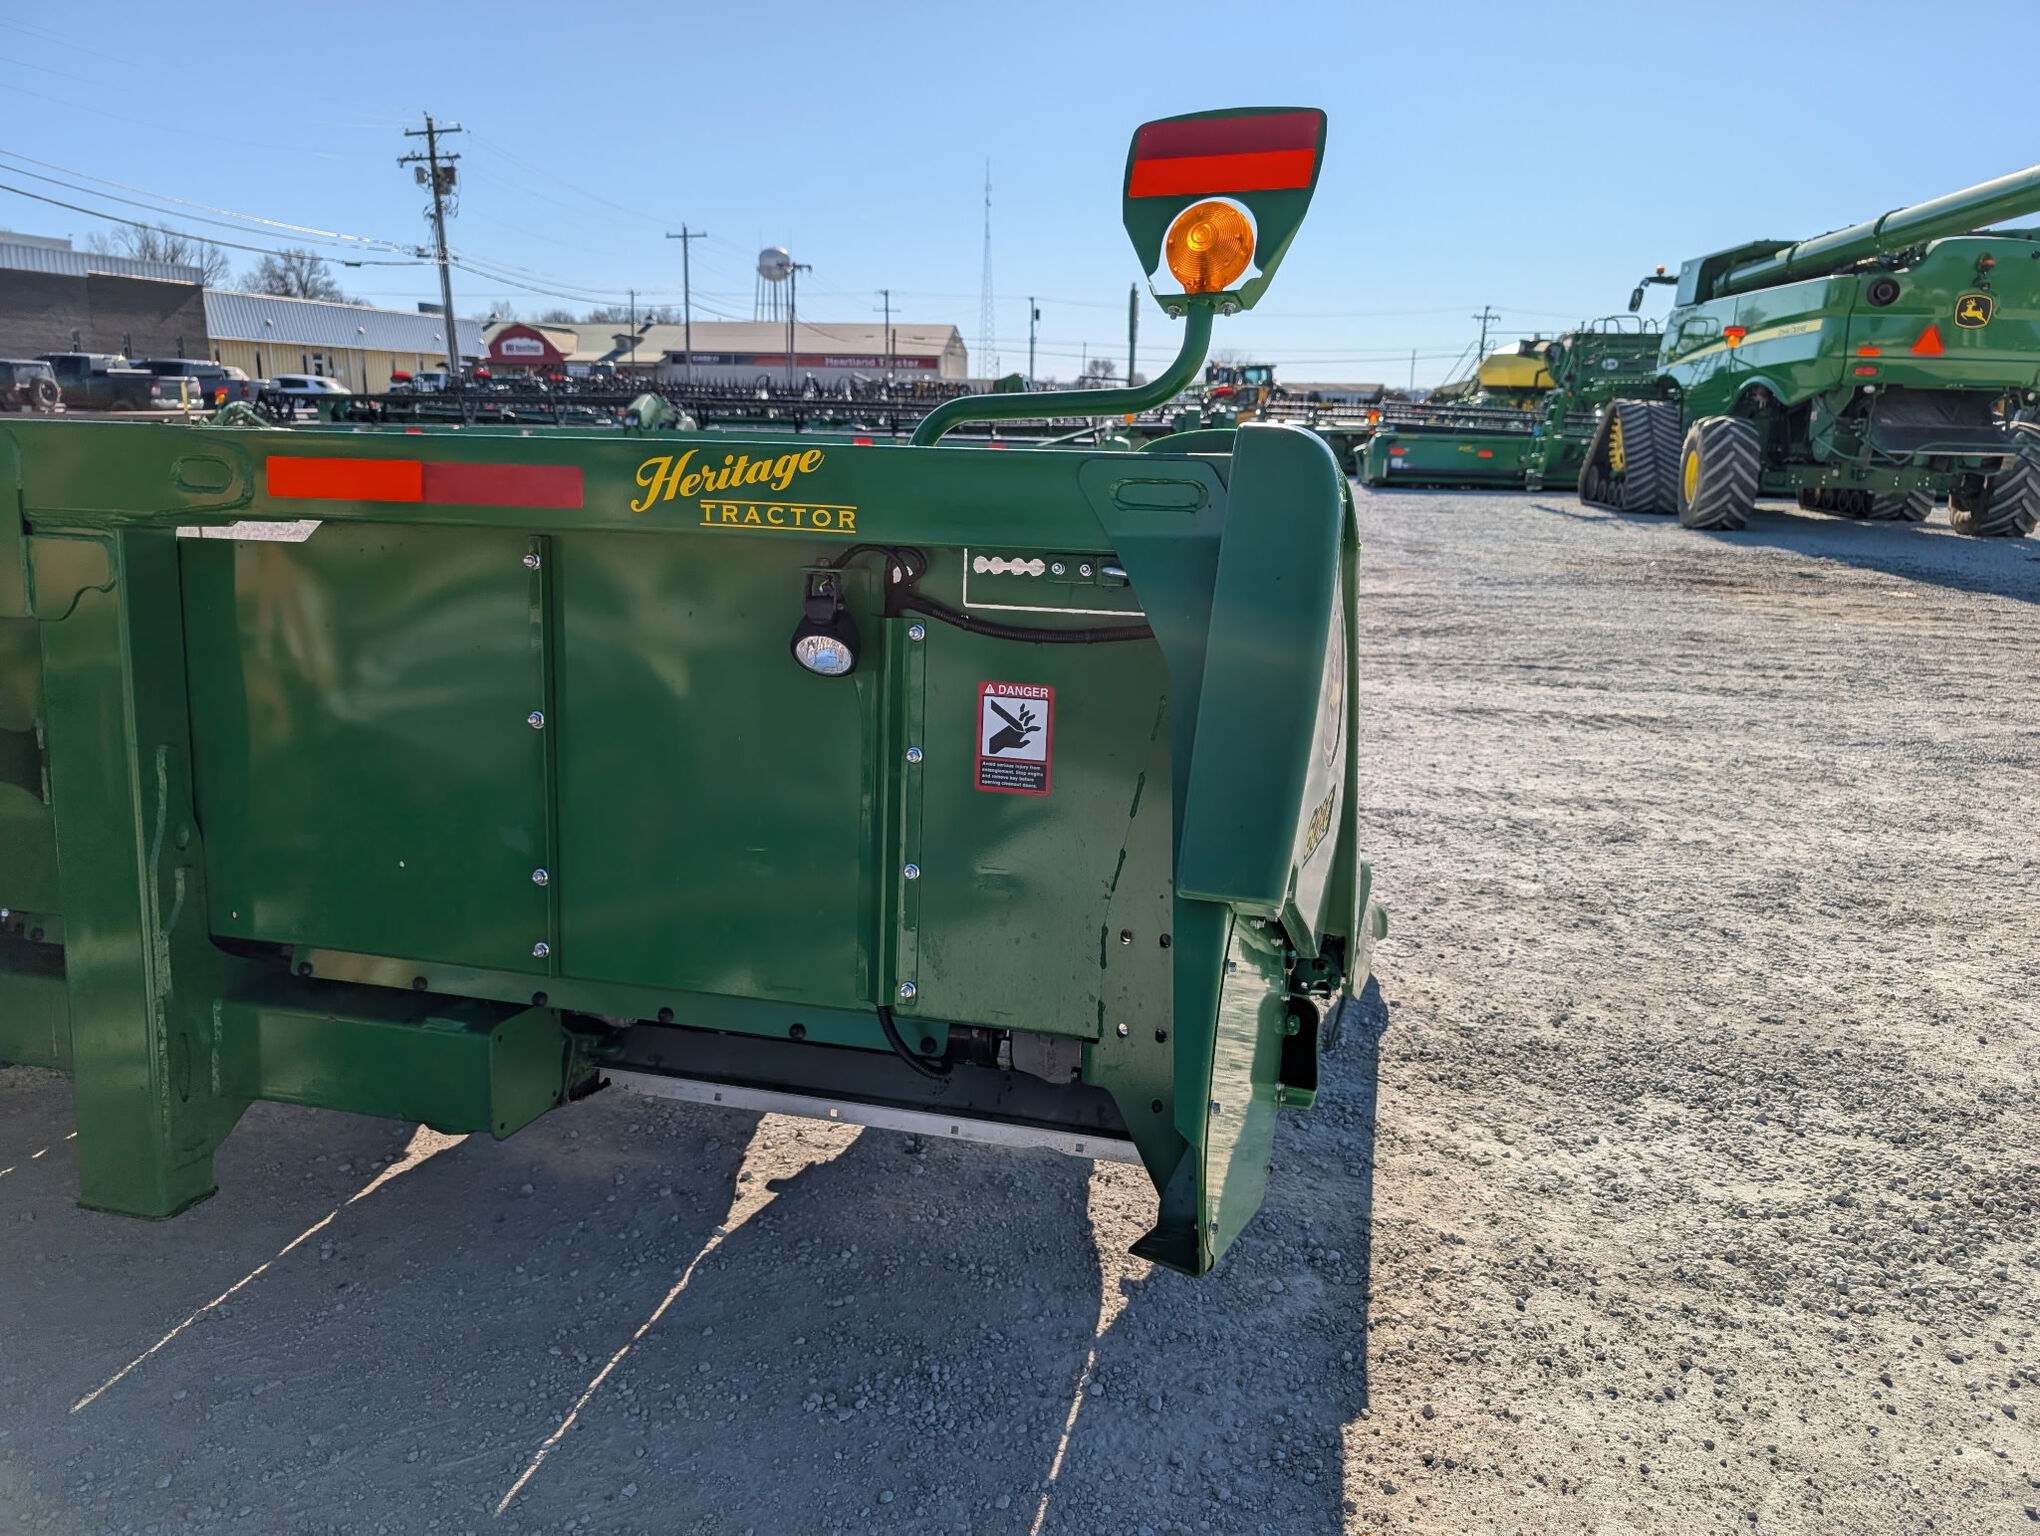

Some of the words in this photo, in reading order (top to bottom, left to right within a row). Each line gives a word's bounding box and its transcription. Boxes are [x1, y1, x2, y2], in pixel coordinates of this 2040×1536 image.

[630, 449, 825, 513] Heritage
[700, 503, 856, 529] TRACTOR
[998, 684, 1049, 698] DANGER
